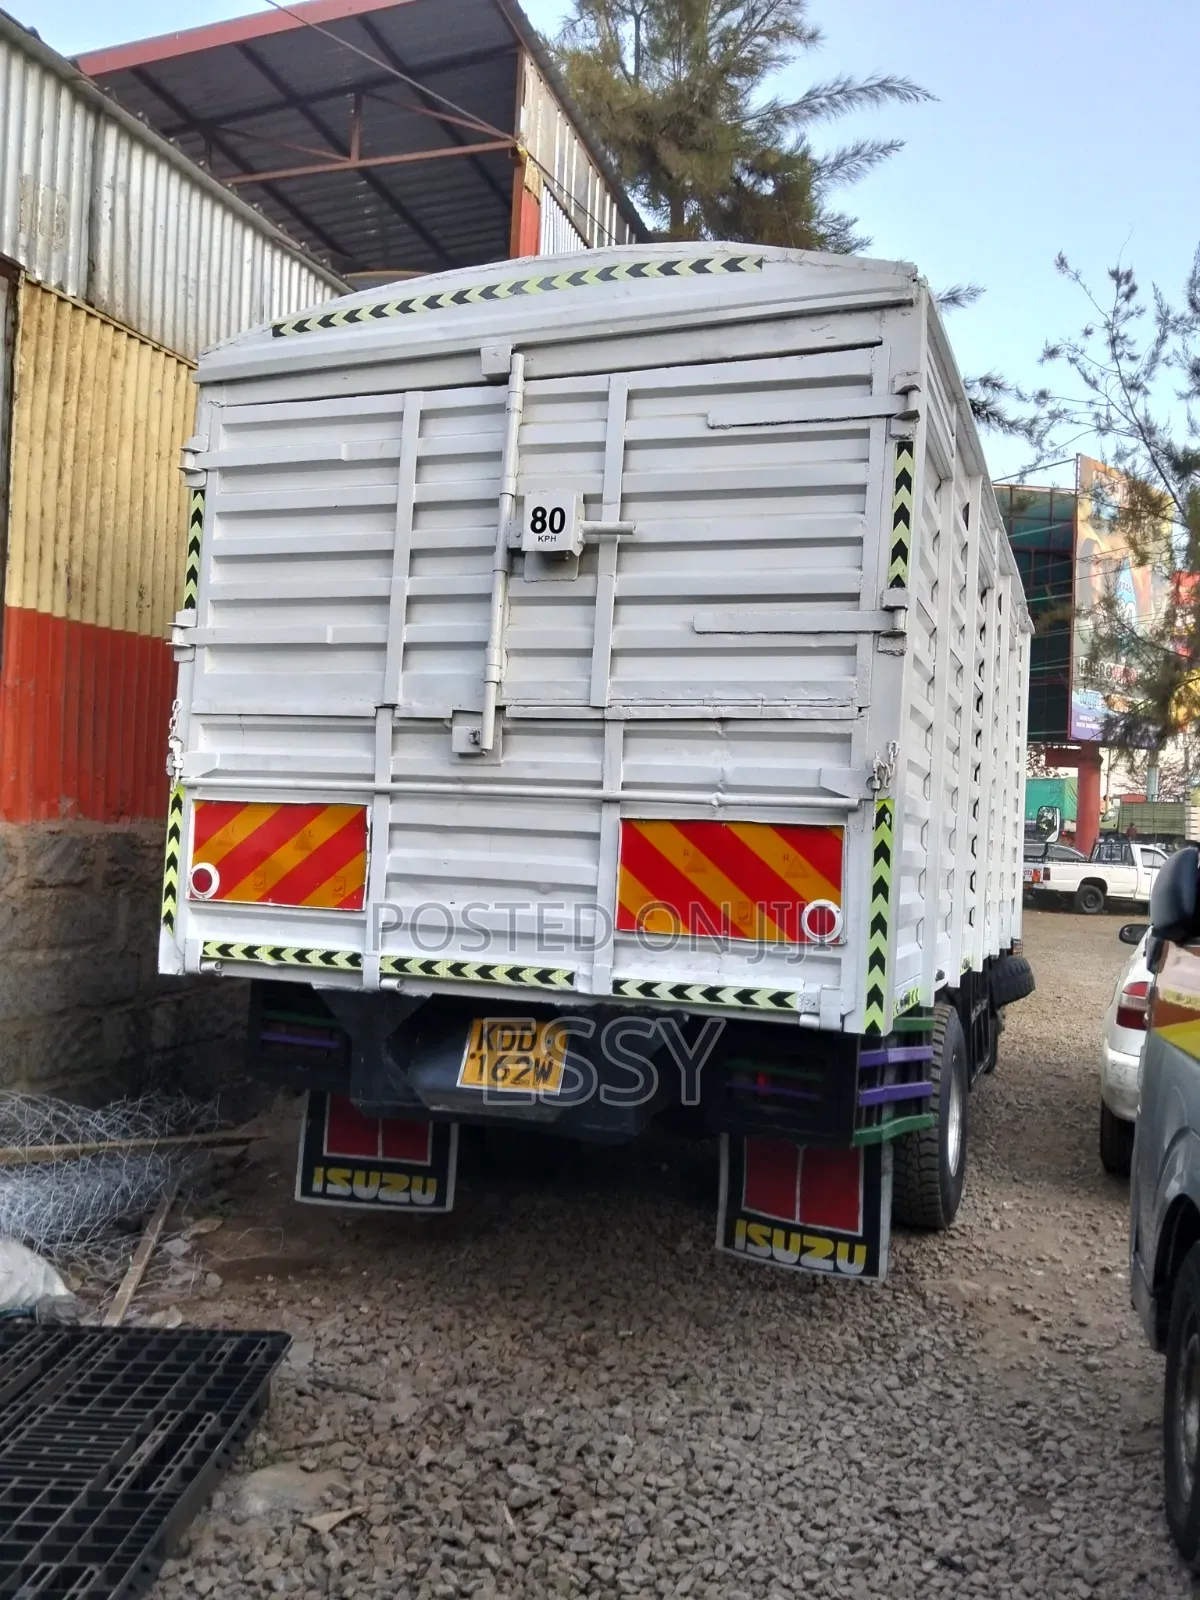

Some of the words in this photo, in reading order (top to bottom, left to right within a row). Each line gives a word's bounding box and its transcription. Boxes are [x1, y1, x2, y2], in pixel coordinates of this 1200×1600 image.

[530, 506, 566, 534] 80
[477, 1054, 554, 1085] 162W
[312, 1166, 438, 1205] ISUZU
[733, 1218, 867, 1275] ISUZU
